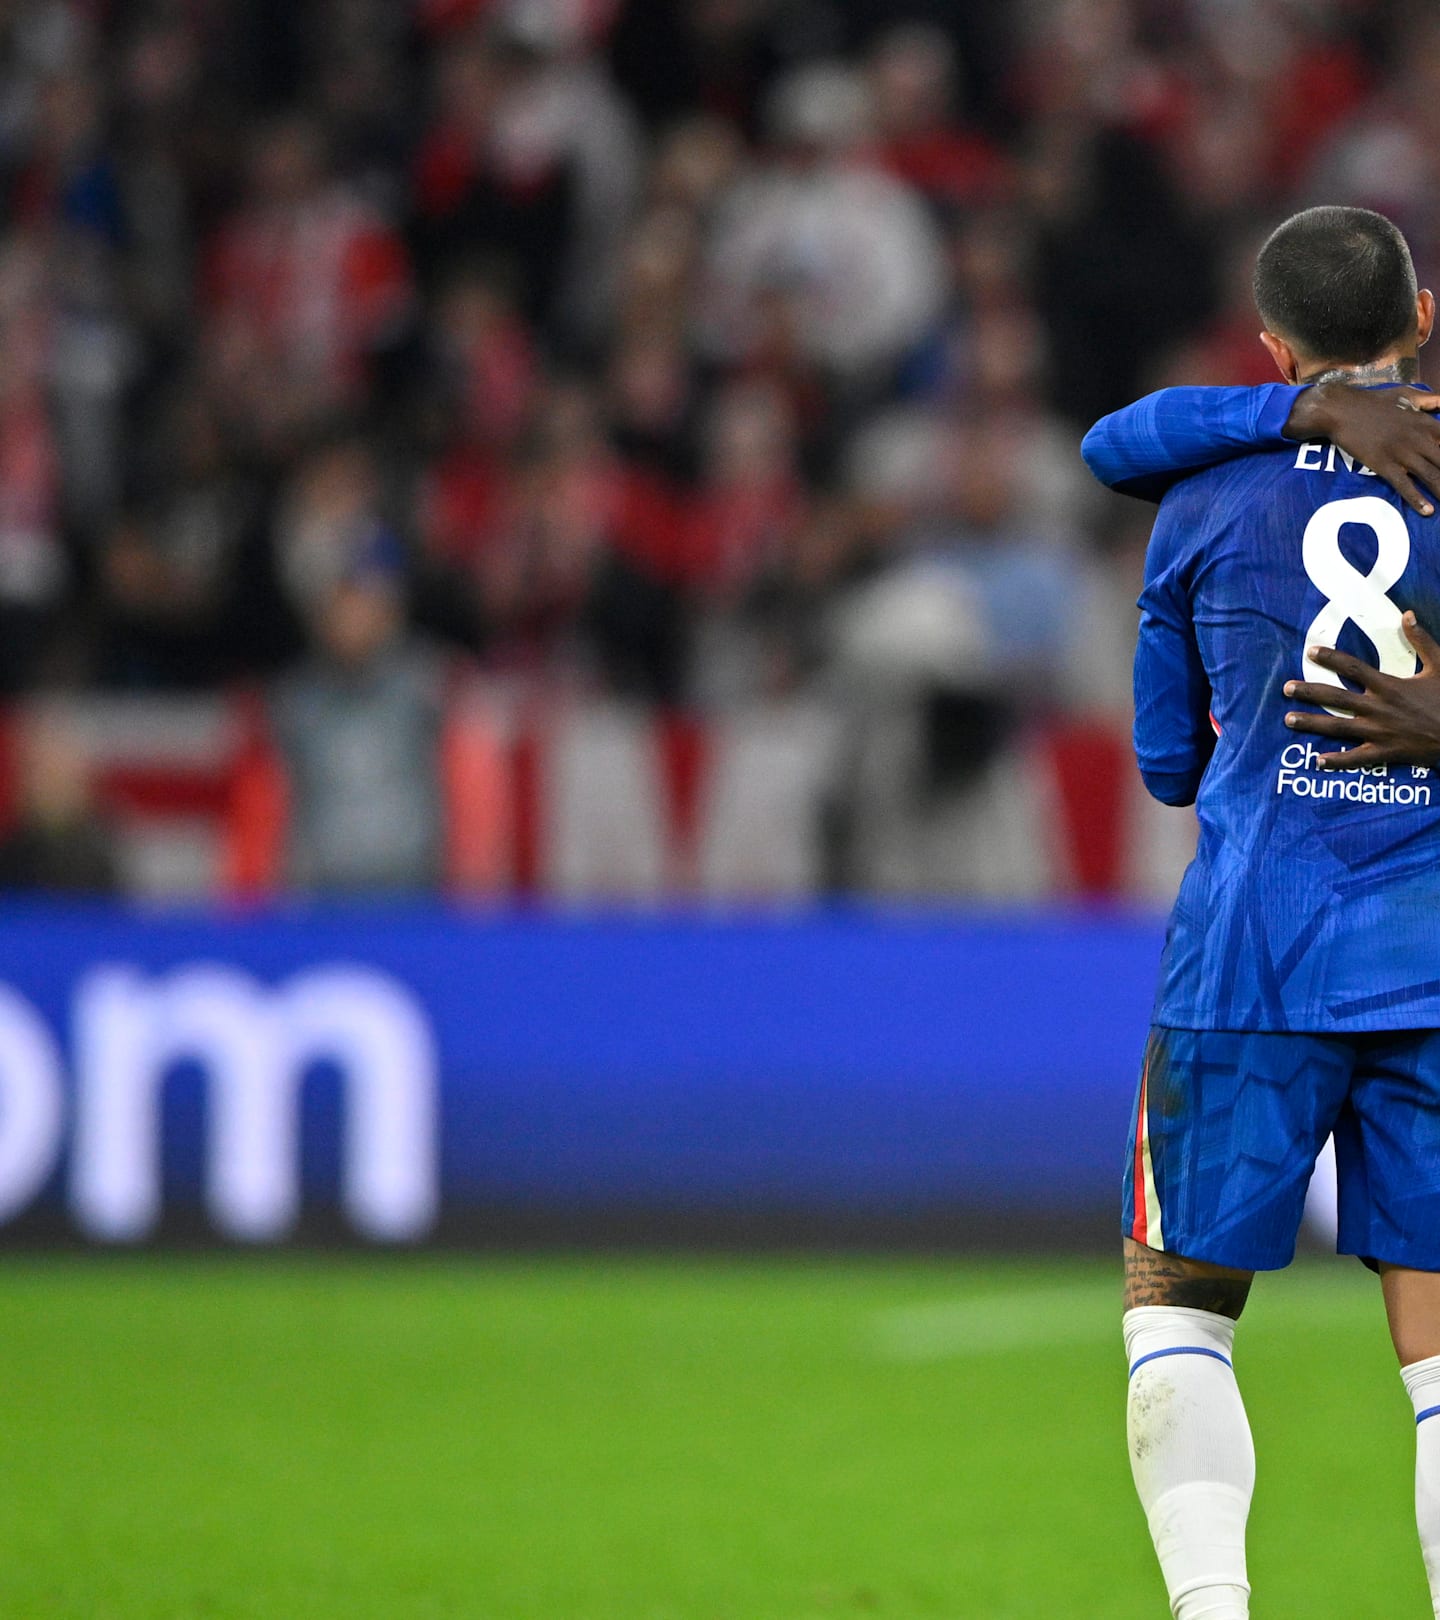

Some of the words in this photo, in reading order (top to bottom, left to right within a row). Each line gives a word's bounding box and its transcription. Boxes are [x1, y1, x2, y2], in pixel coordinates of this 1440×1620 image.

[1302, 496, 1417, 719] 8
[1277, 769, 1431, 805] Foundation
[0, 962, 438, 1244] m
